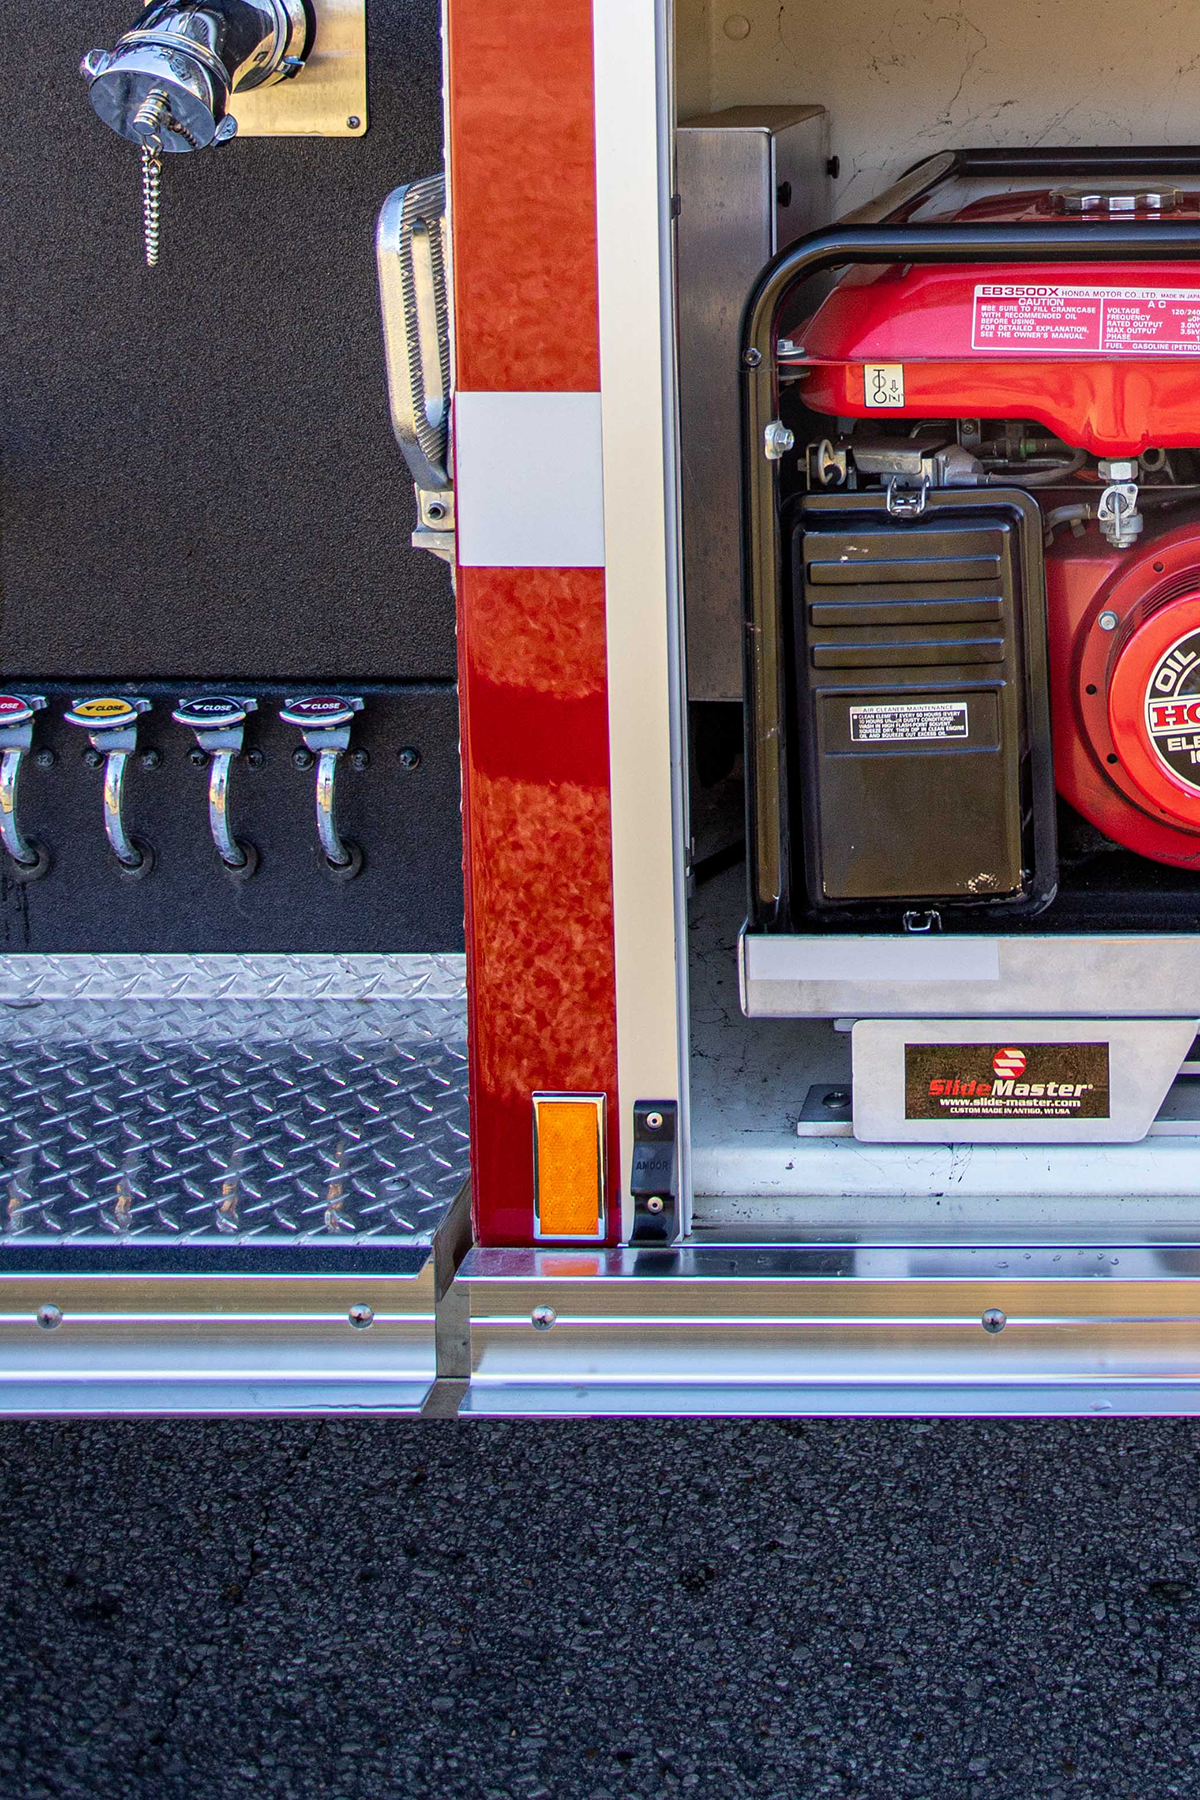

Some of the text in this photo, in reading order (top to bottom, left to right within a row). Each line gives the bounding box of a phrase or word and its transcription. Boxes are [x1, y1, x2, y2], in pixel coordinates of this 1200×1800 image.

[982, 286, 1059, 296] EB3500X
[1093, 290, 1122, 298] MOTOR
[1018, 298, 1064, 306] CAUTION
[1050, 306, 1096, 314] CRANKCASE
[1051, 332, 1086, 340] MANUAL.
[1154, 649, 1197, 693] OIL
[939, 1098, 1081, 1107] www.slide-master.com
[1012, 1107, 1043, 1115] ANTIGO,
